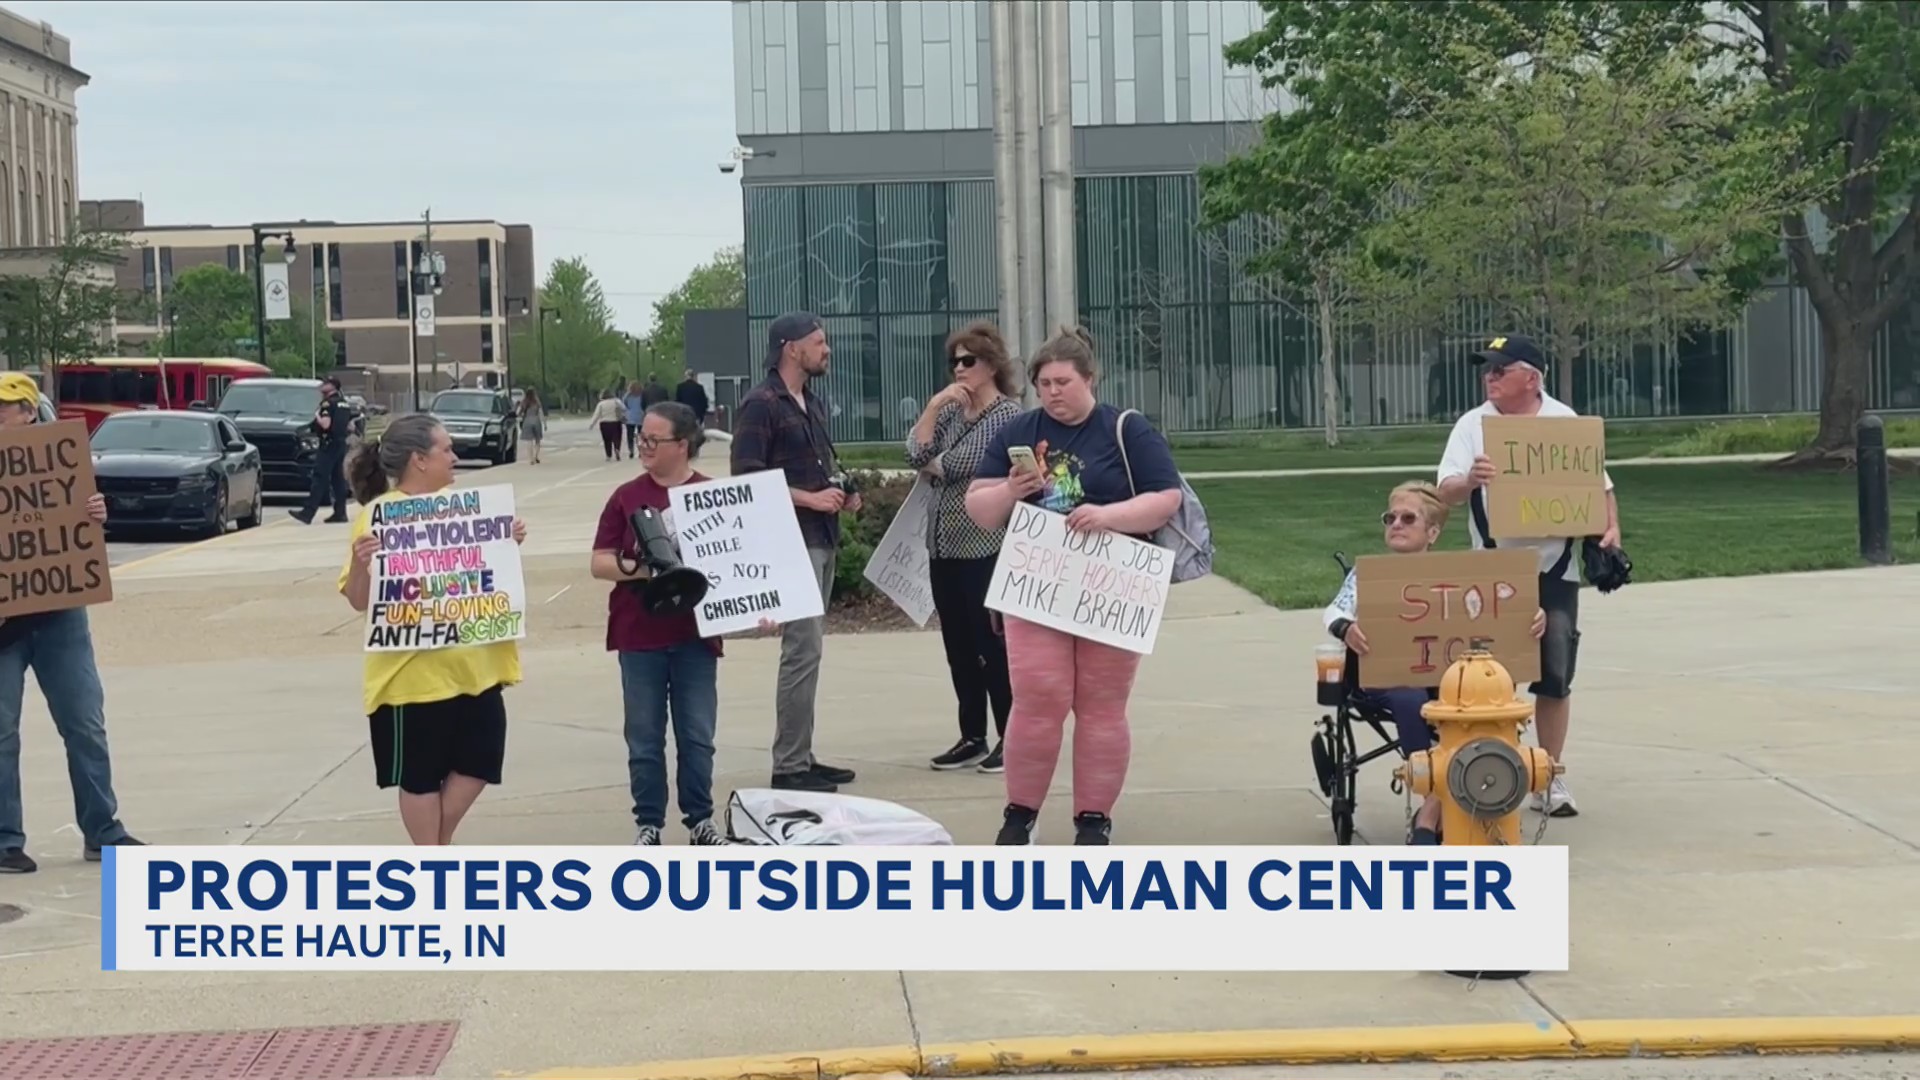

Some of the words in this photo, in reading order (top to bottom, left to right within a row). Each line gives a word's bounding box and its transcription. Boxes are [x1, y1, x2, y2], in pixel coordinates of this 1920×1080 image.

[0, 438, 79, 480] BLIC
[1503, 441, 1605, 476] IMPEACH
[0, 475, 76, 516] ONEY
[371, 490, 481, 526] AMERICAN
[684, 483, 753, 513] FASCISM
[1520, 492, 1592, 525] NOW
[12, 511, 44, 524] FOR
[372, 515, 514, 551] NON-VIOLENT
[682, 511, 725, 542] WITH
[732, 515, 744, 529] A
[0, 521, 93, 563] UBLIC
[695, 536, 742, 558] BIBLE
[1012, 506, 1047, 540] DO
[1062, 520, 1114, 561] YOUR
[1122, 541, 1164, 576] JOB
[376, 545, 486, 577] TRUTHFUL
[733, 563, 770, 580] NOT
[1008, 541, 1074, 582] SERVE
[1080, 560, 1162, 607] HOOSIERS
[0, 559, 101, 603] HOOLS
[379, 569, 494, 601] INCLUSIVE
[372, 591, 510, 624] FUN-LOVING
[703, 589, 781, 621] CHRISTIAN
[1000, 570, 1061, 617] MIKE
[1073, 589, 1154, 638] BRAUN
[1398, 581, 1517, 622] STOP
[368, 611, 522, 647] ANTI-FASCIST
